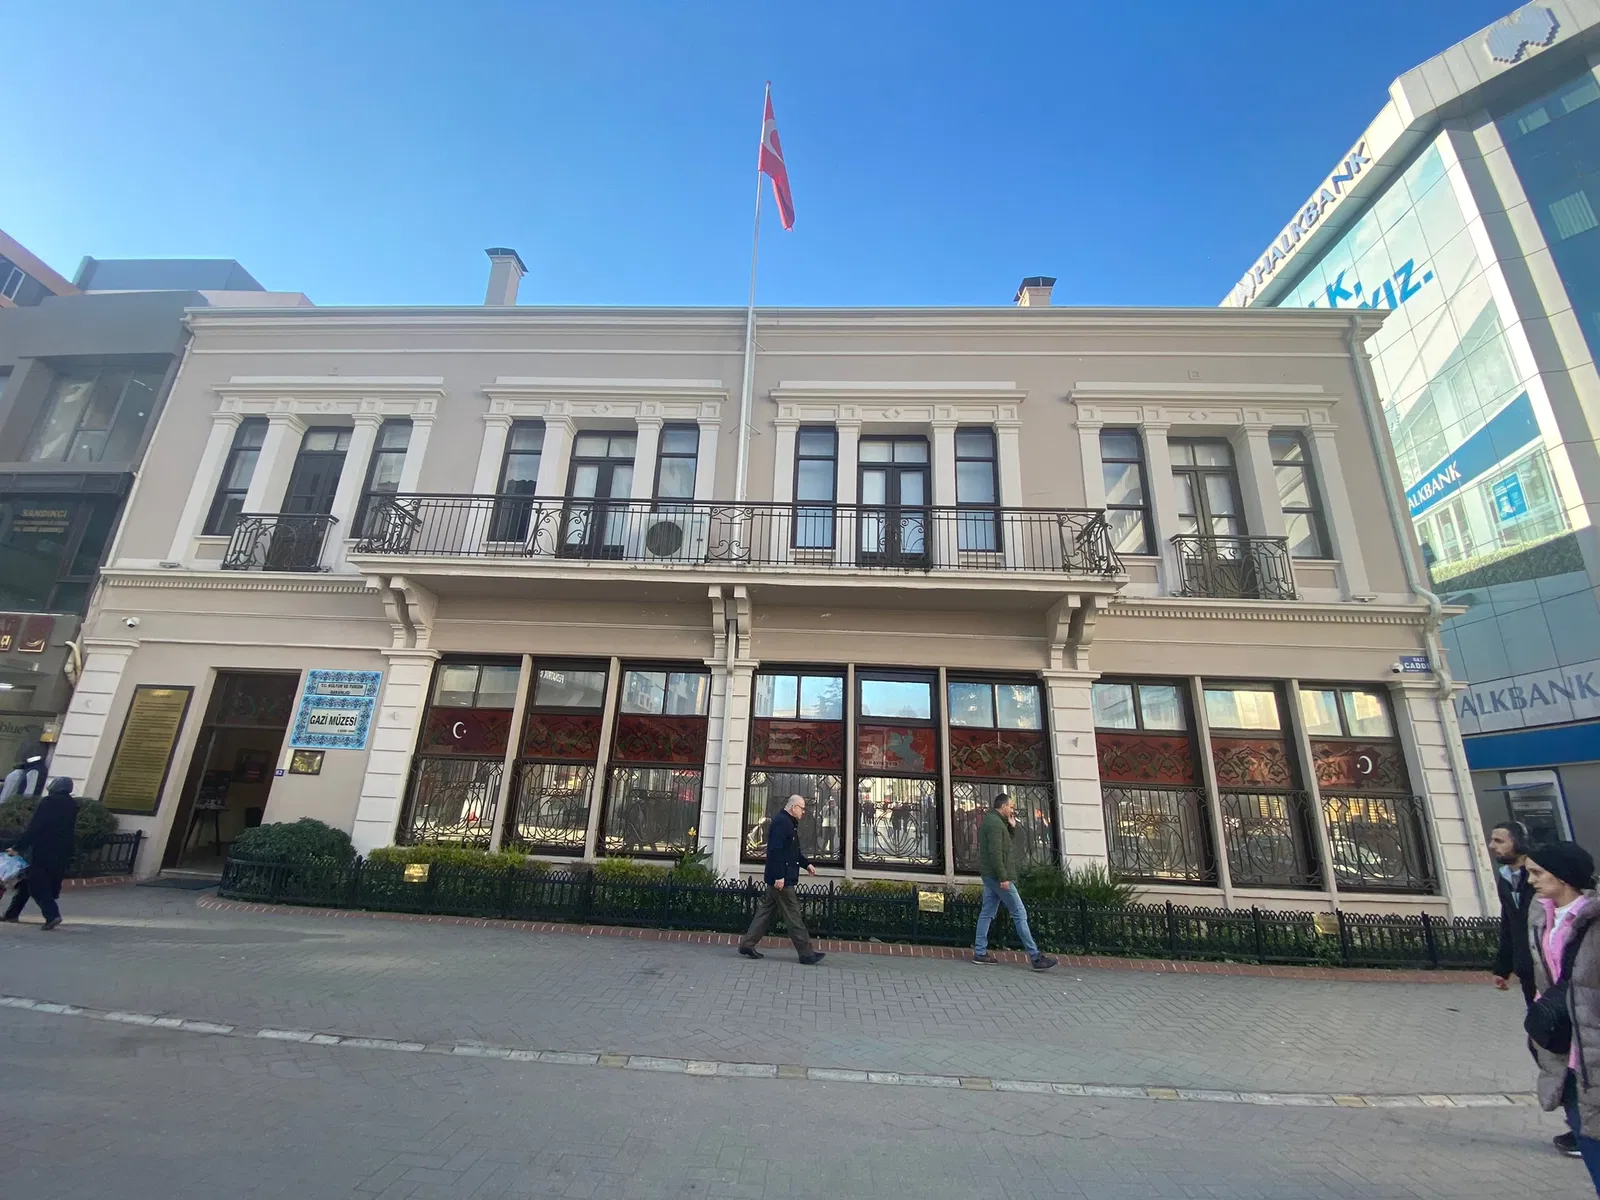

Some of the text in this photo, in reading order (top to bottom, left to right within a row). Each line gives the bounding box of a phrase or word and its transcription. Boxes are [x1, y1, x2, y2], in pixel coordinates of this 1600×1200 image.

[1253, 141, 1371, 285] HALKBANK
[1460, 671, 1600, 719] ALKBANK
[310, 713, 358, 726] GAZİ MÜZESİ
